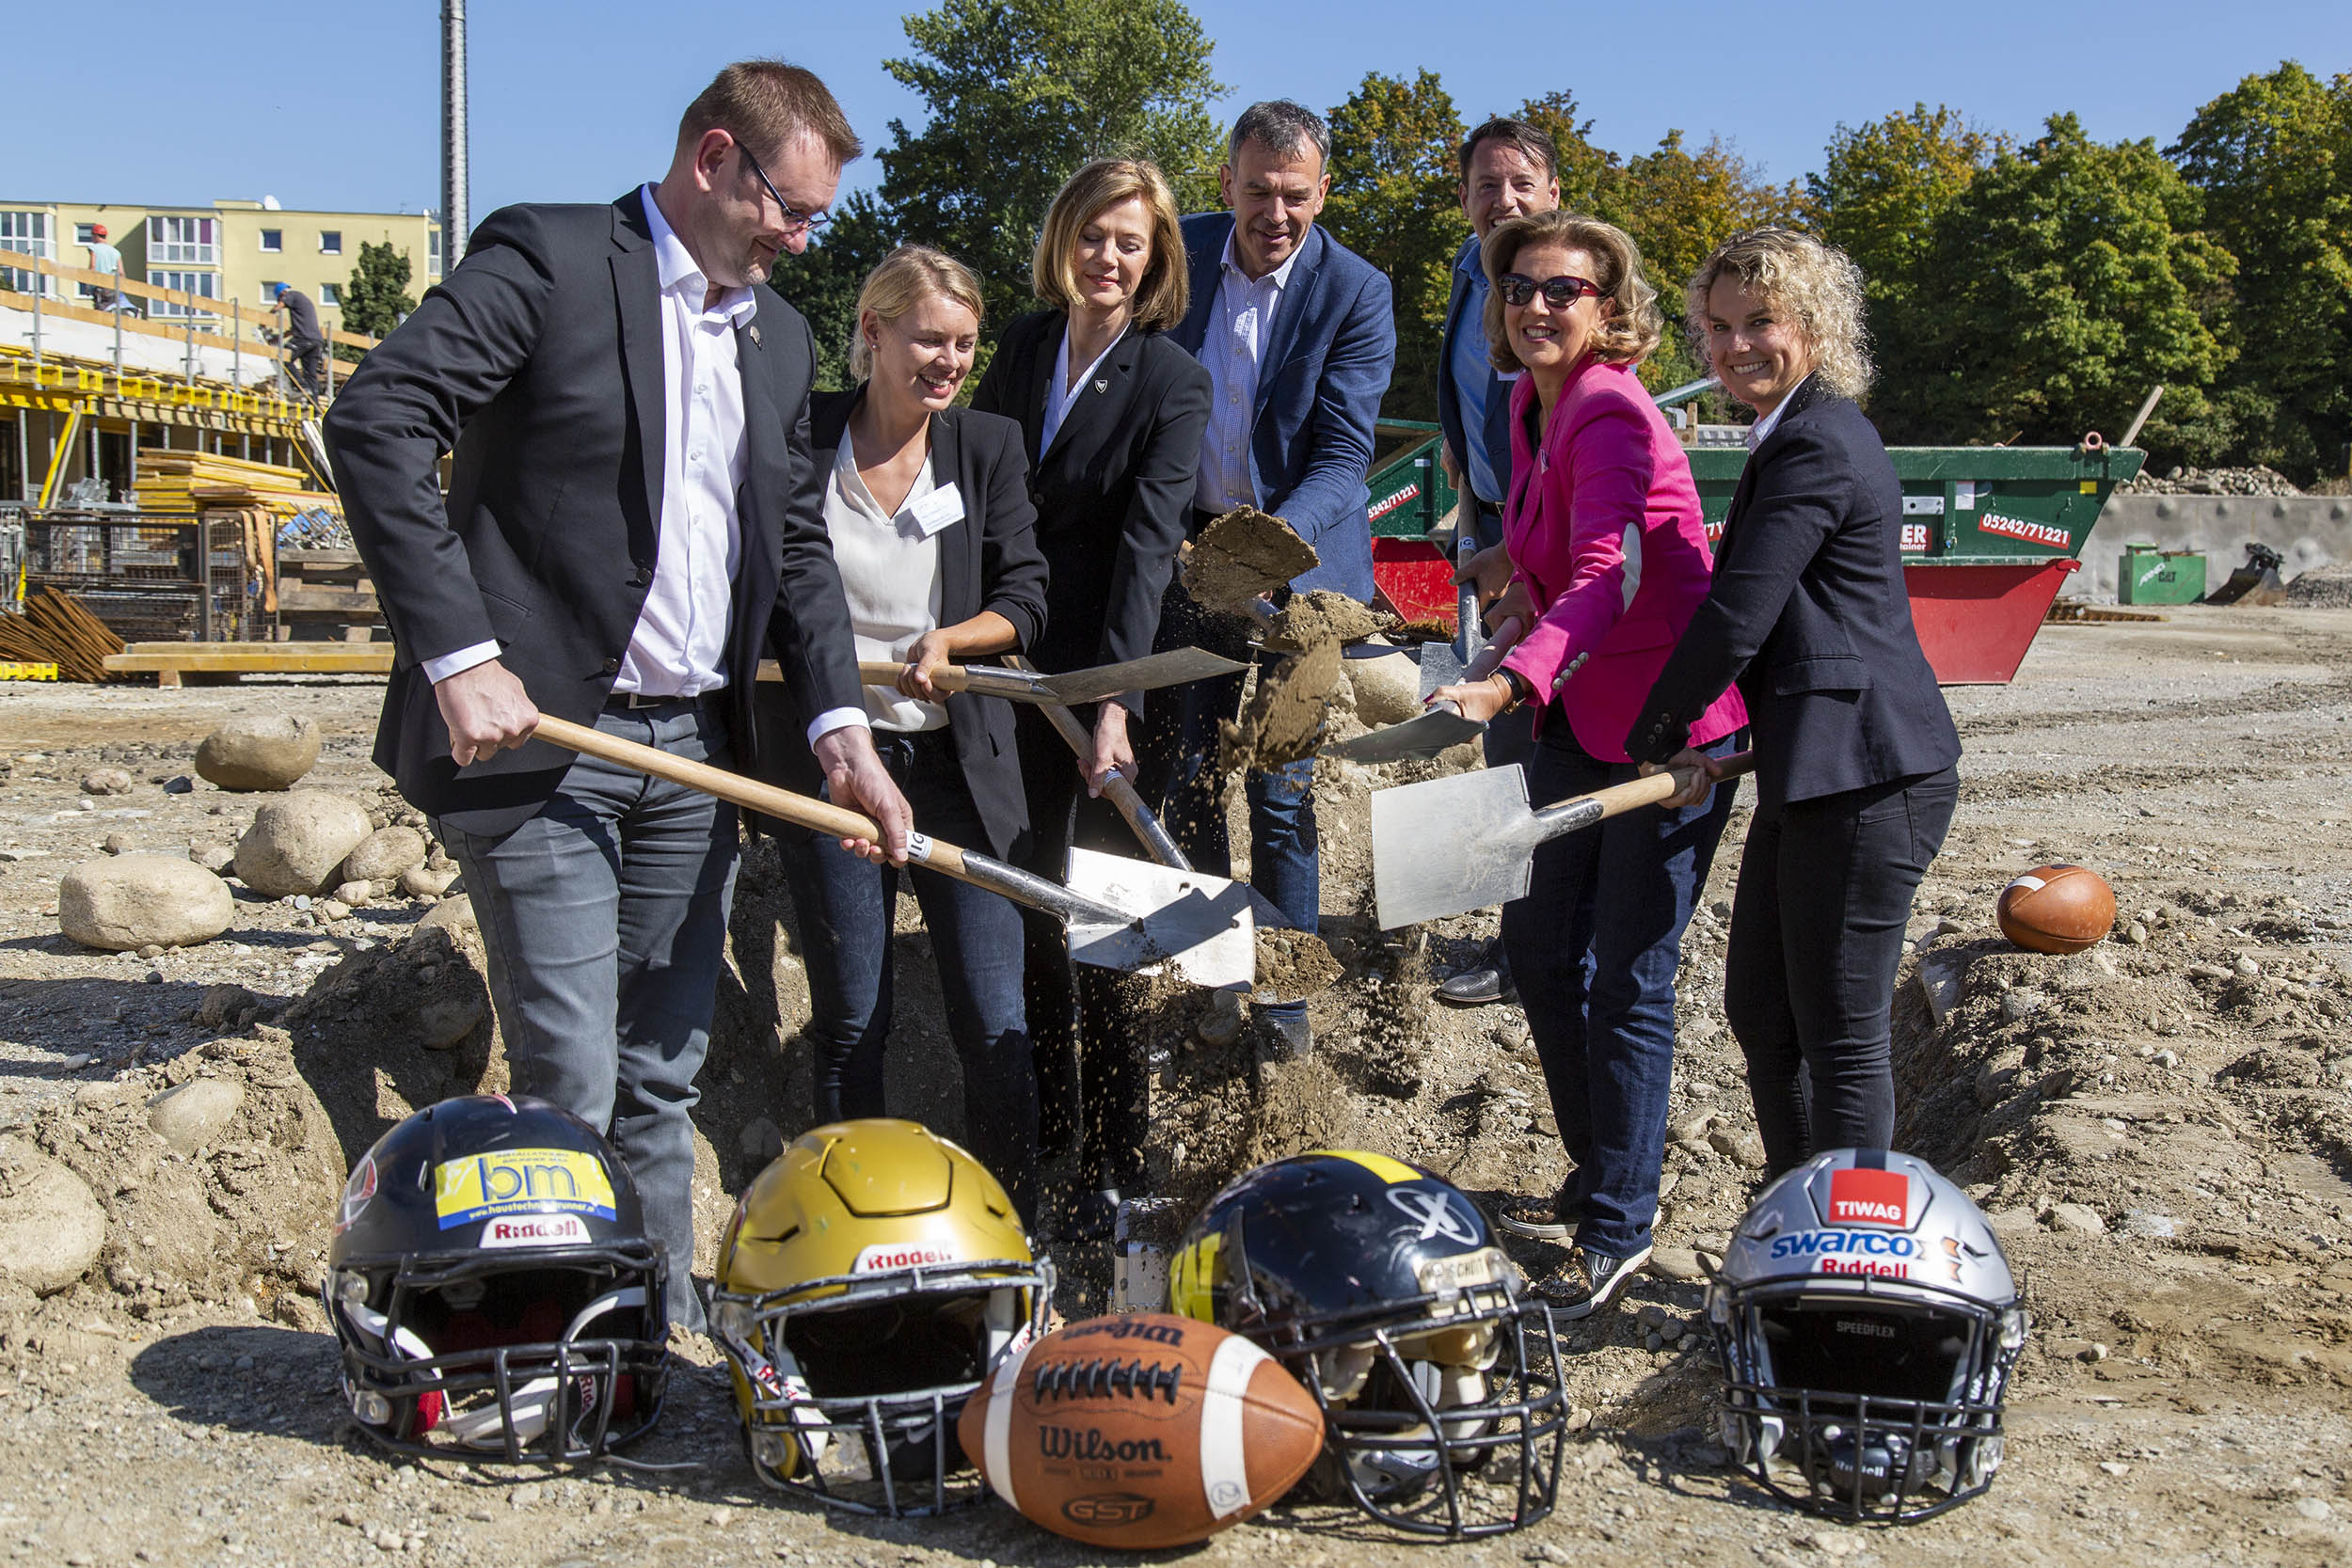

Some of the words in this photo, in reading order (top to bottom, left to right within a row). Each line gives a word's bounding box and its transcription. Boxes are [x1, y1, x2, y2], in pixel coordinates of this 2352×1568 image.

[1982, 513, 2070, 545] 05242/71221
[2158, 571, 2176, 582] CAT
[1836, 1200, 1902, 1221] TIWAG
[495, 1220, 578, 1240] Riddell
[867, 1250, 952, 1270] Riddel
[1821, 1259, 1908, 1279] Riddell
[1836, 1321, 1896, 1338] SPEEDFLEX
[1068, 1498, 1150, 1520] GST
